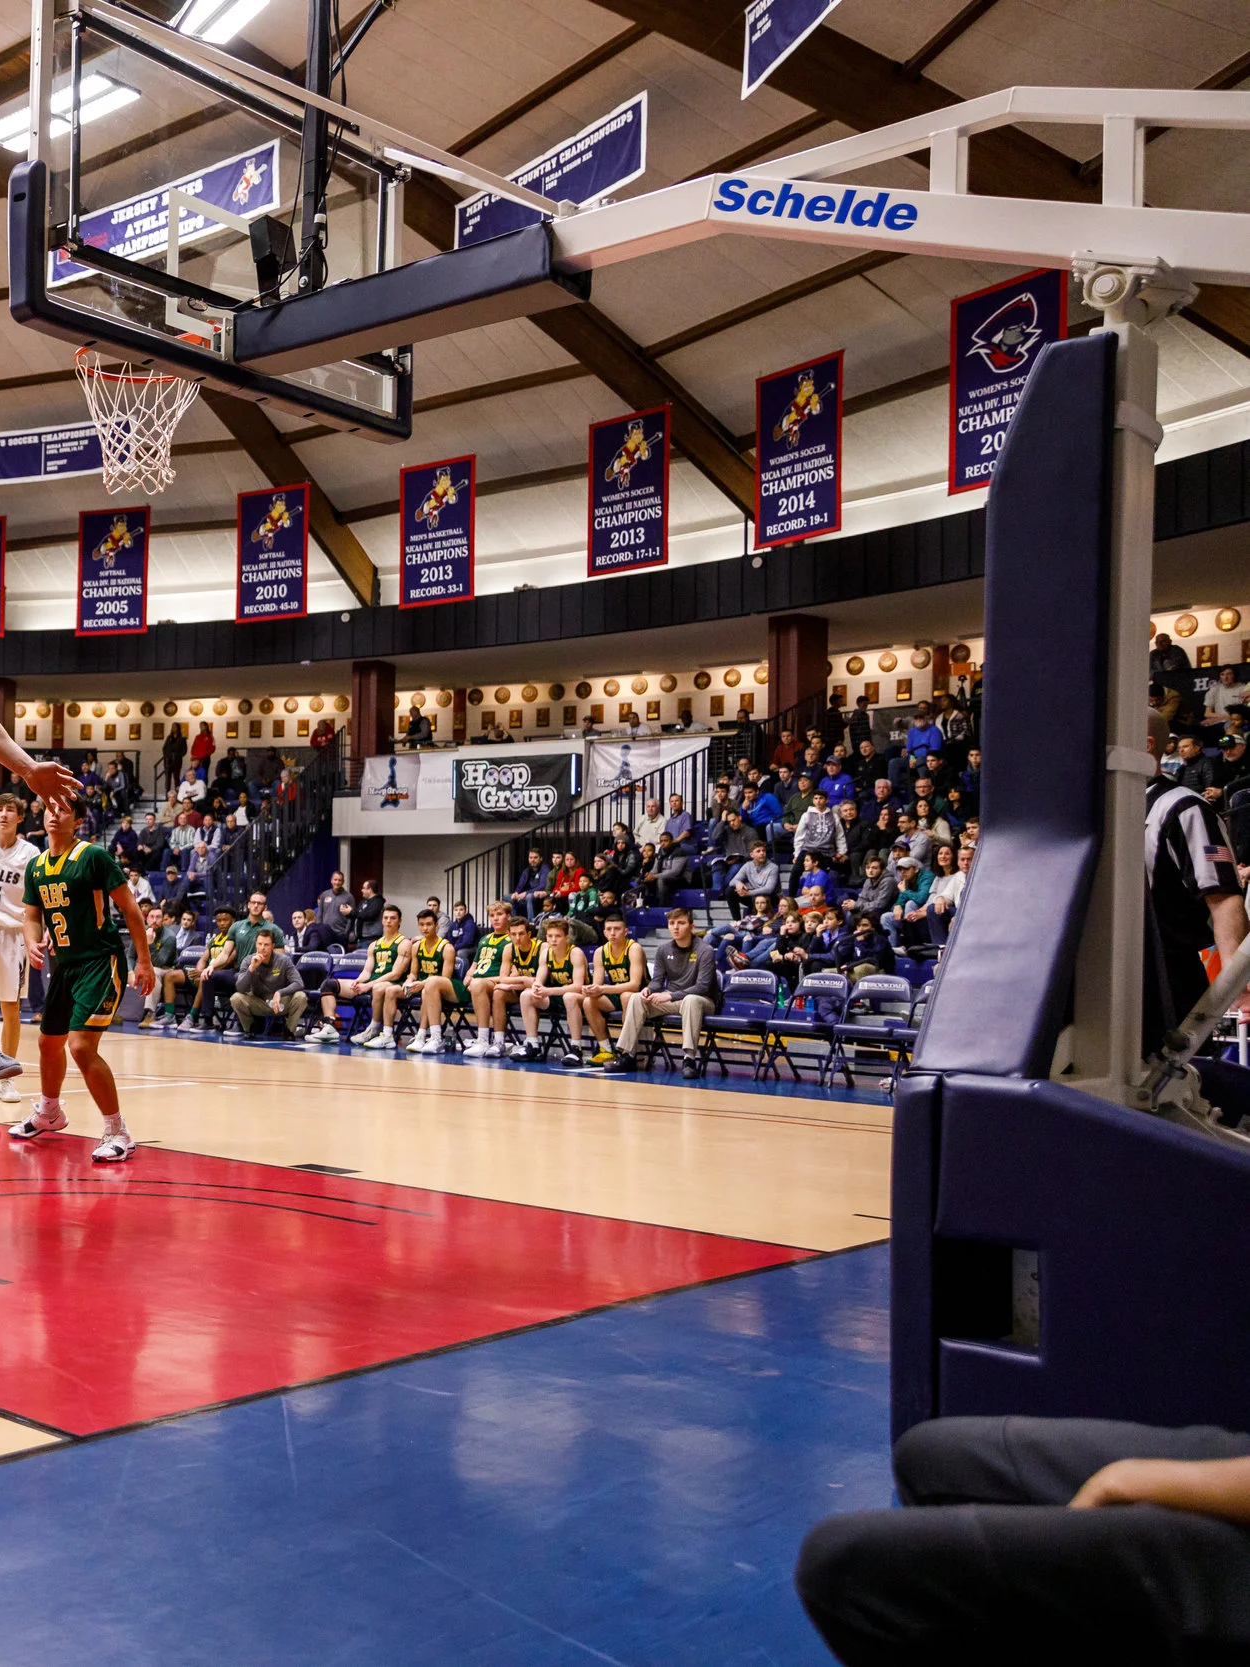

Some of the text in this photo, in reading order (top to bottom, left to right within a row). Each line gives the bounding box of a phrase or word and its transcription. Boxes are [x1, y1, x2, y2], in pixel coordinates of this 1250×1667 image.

[518, 110, 633, 187] COUNTRY CHAMPIONSHIPS
[111, 196, 158, 224] JERSEY
[466, 196, 489, 217] MEN'S
[713, 179, 918, 231] Schelde
[125, 206, 187, 238] ATHLEC
[108, 215, 204, 257] CHAMPIONHIPS
[968, 381, 1008, 399] WOMEN'S
[1010, 374, 1028, 388] SOC
[958, 403, 983, 418] NJCAA
[985, 398, 1000, 410] DIV.
[1002, 394, 1012, 406] III
[958, 406, 1016, 434] CHAMP
[8, 436, 39, 446] SOCCER
[41, 426, 103, 443] CHAMPIONSH
[980, 430, 1006, 456] 20
[769, 444, 826, 466] WOMEN'S SOCCER
[761, 454, 834, 482] NJCAA DIV. III NATIONAL
[965, 460, 996, 479] RECO
[761, 466, 834, 496] CHAMPIONS
[602, 486, 654, 503] WOMEN'S SOCCER
[778, 490, 816, 516] 2014
[594, 508, 612, 517] NJCAA
[613, 504, 624, 513] DIV.
[633, 496, 662, 508] NATIONAL
[594, 506, 662, 530] CHAMPIONS
[766, 512, 828, 536] RECORD: 19-1
[406, 537, 468, 553] NJCAA DIV. III NATIONAL
[410, 528, 464, 542] MEN'S BASKETBALL
[610, 527, 645, 548] 2013
[258, 551, 286, 560] SOFTBALL
[258, 562, 269, 570] DIV.
[277, 559, 302, 568] NATIONAL
[406, 546, 468, 565] CHAMPIONS
[596, 546, 660, 566] RECORD: 17-1-1
[118, 577, 142, 585] NATIONAL
[242, 567, 302, 583] CHAMPIONS
[420, 564, 453, 584] 2013
[82, 585, 142, 598] CHAMPIONS
[256, 584, 288, 600] 2010
[410, 583, 463, 598] RECORD: 33-1
[95, 600, 128, 615] 2005
[244, 601, 298, 614] RECORD: 45-10
[84, 618, 140, 628] RECORD: 49-8-1
[463, 762, 530, 789] Hoop
[479, 785, 556, 812] Group
[38, 882, 70, 909] RBC
[51, 912, 70, 947] 2
